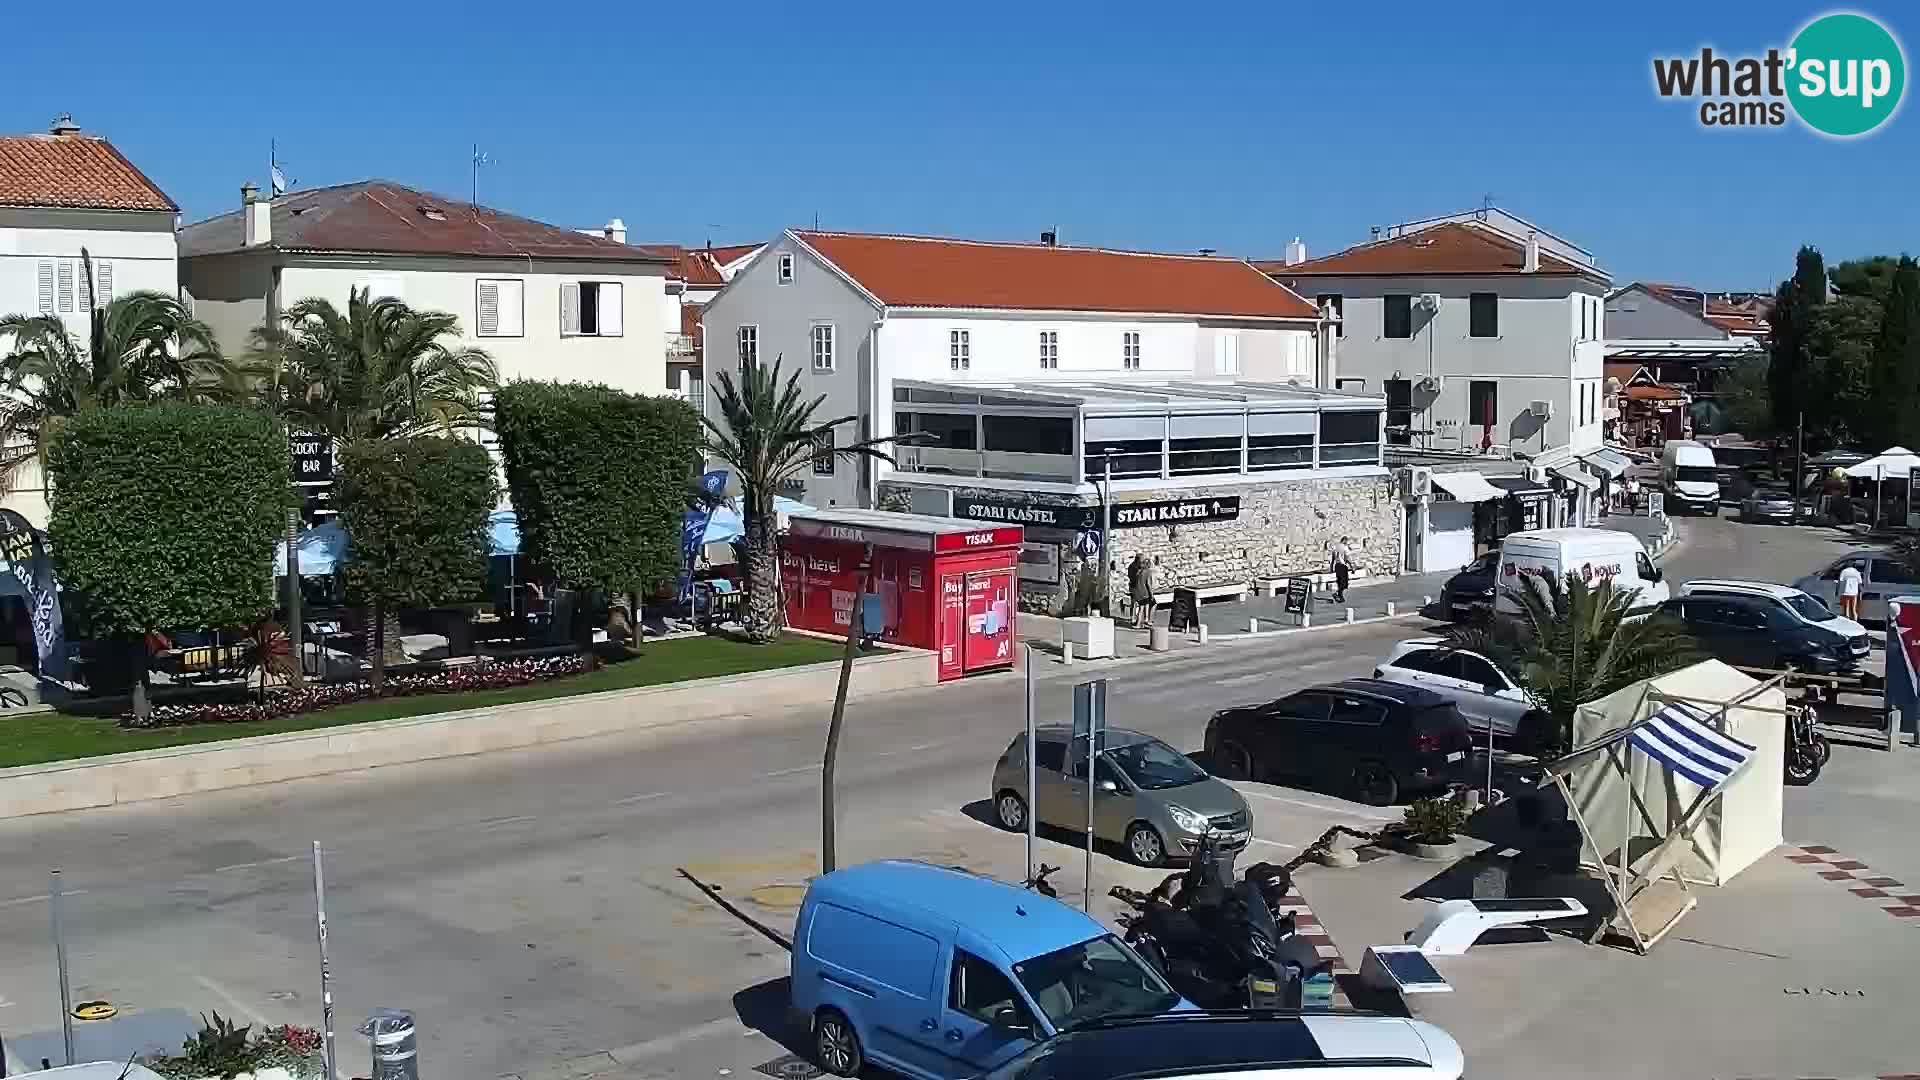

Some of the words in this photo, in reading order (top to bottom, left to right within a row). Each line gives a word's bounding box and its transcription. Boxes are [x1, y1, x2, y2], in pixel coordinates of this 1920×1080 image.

[303, 460, 321, 473] BAR
[968, 504, 1005, 519] STARI
[1007, 505, 1057, 524] KAŠTEL
[1117, 507, 1157, 523] STARI
[1159, 502, 1209, 520] KAŠTEL
[965, 532, 994, 545] TISAK
